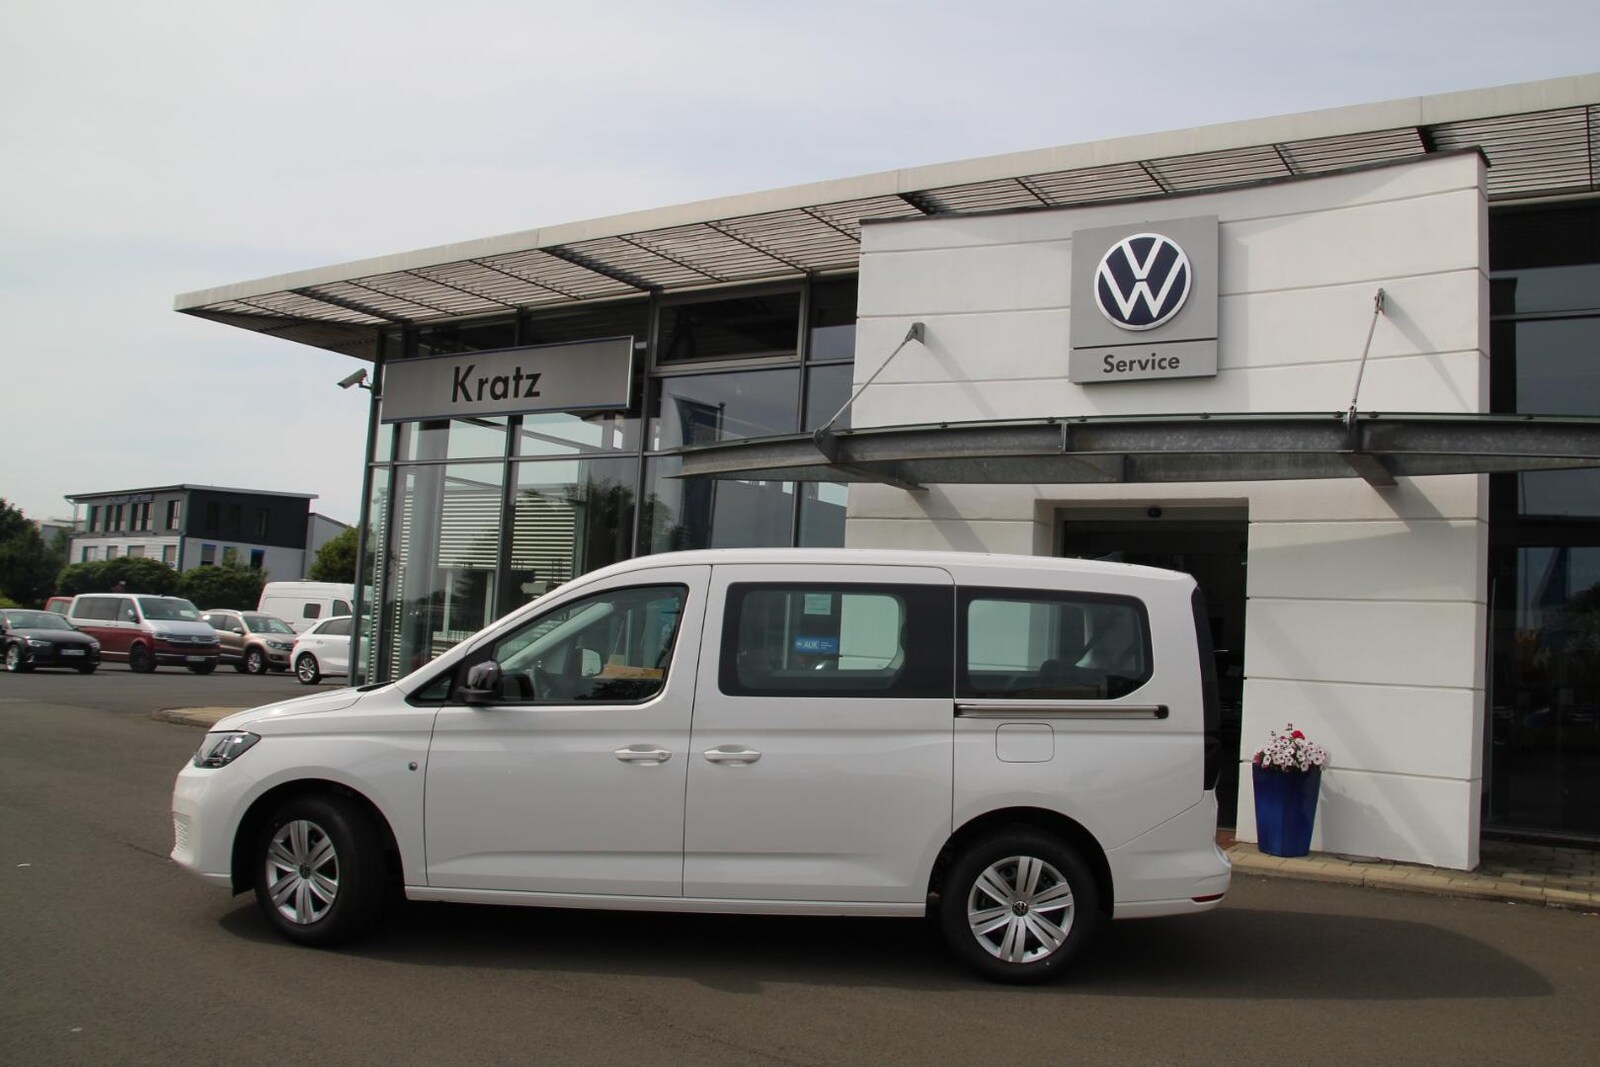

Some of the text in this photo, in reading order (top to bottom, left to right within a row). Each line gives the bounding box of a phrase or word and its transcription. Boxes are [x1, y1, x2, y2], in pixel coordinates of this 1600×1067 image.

[1097, 235, 1188, 328] VW
[1103, 353, 1180, 373] Service
[451, 364, 542, 403] Kratz
